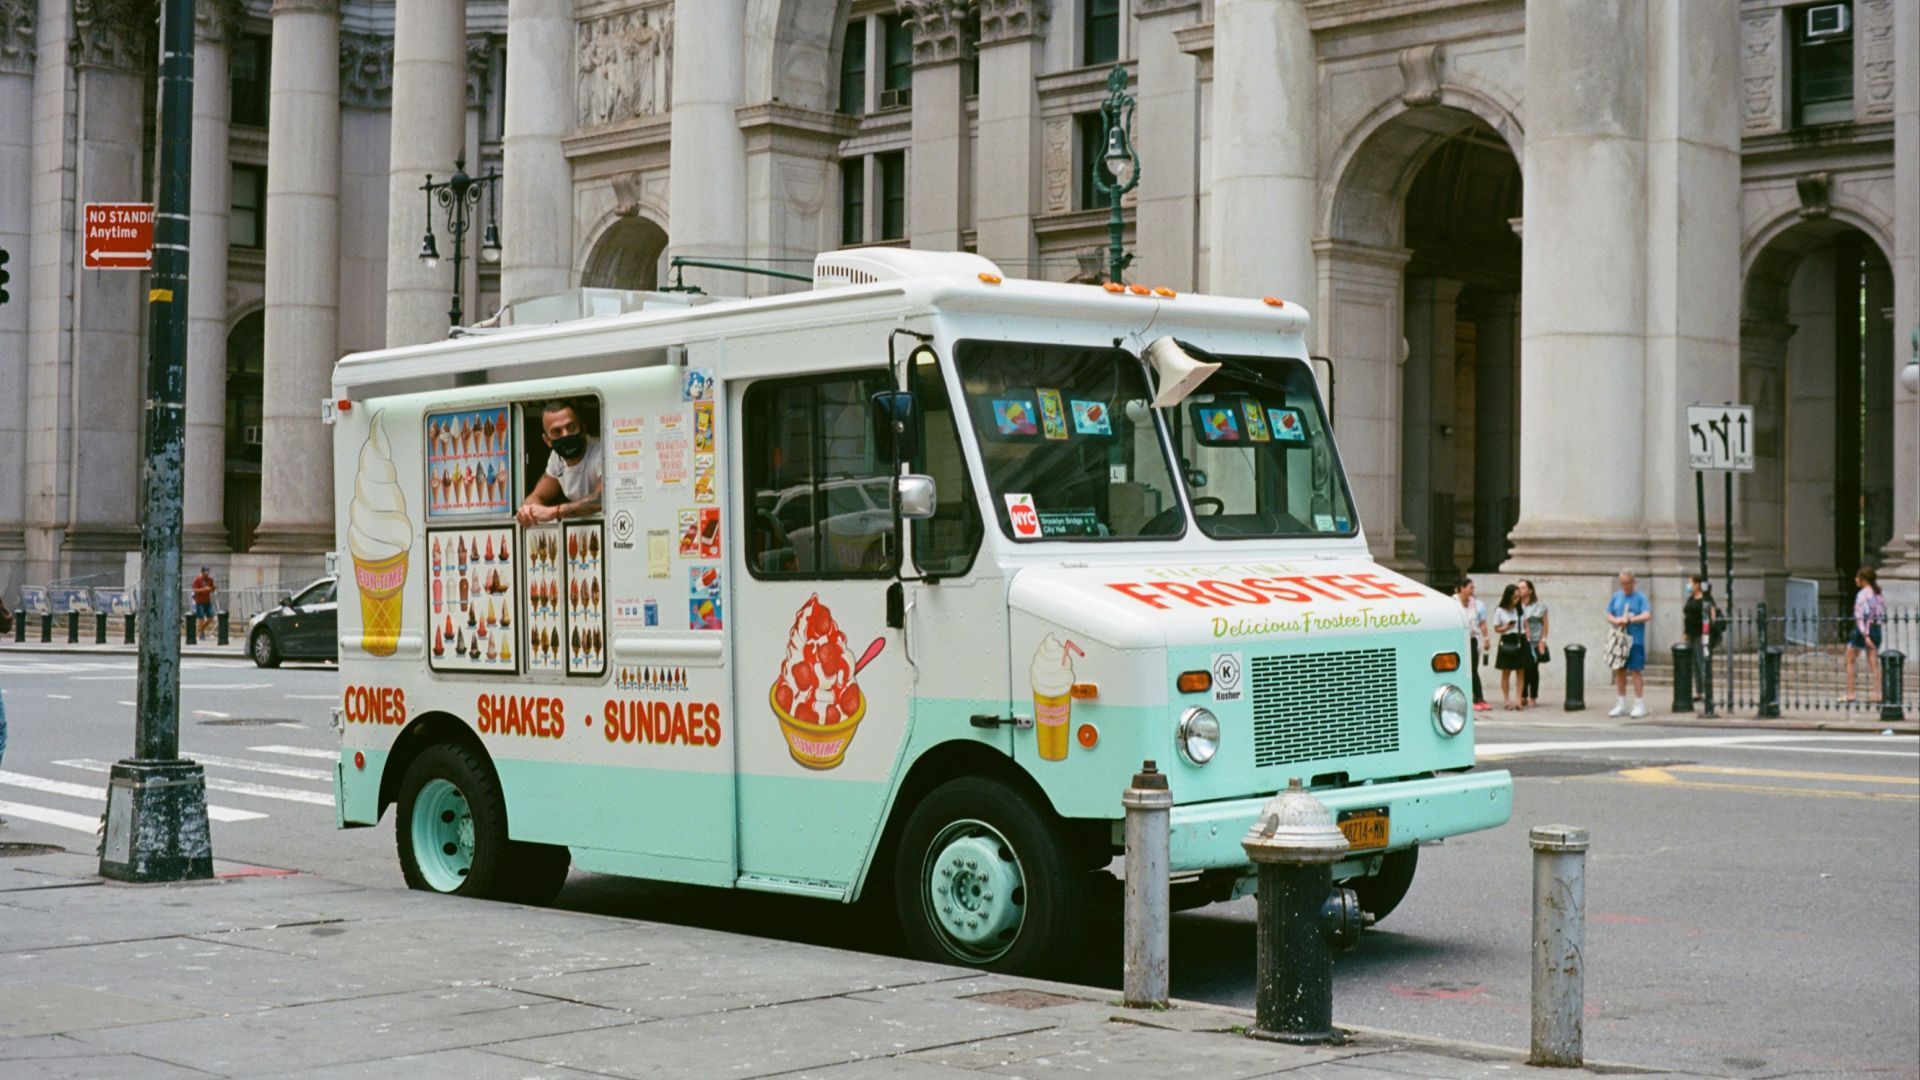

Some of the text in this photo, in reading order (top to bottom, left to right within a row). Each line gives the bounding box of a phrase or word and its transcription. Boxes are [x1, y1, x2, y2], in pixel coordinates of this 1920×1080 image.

[90, 211, 106, 223] NO
[90, 226, 138, 240] Anytime
[1012, 511, 1036, 526] NYC
[1041, 517, 1064, 526] Brooklyn
[1065, 516, 1083, 526] Bridge
[613, 540, 634, 549] Kosher
[357, 564, 403, 589] FUN-TIME
[1103, 573, 1426, 610] FROSTEE
[1211, 607, 1421, 638] Delicious Frostee Treats
[1216, 691, 1240, 701] Kosher
[344, 685, 721, 747] CONES SHAKES SUNDAES
[790, 733, 844, 756] FUN-TIME
